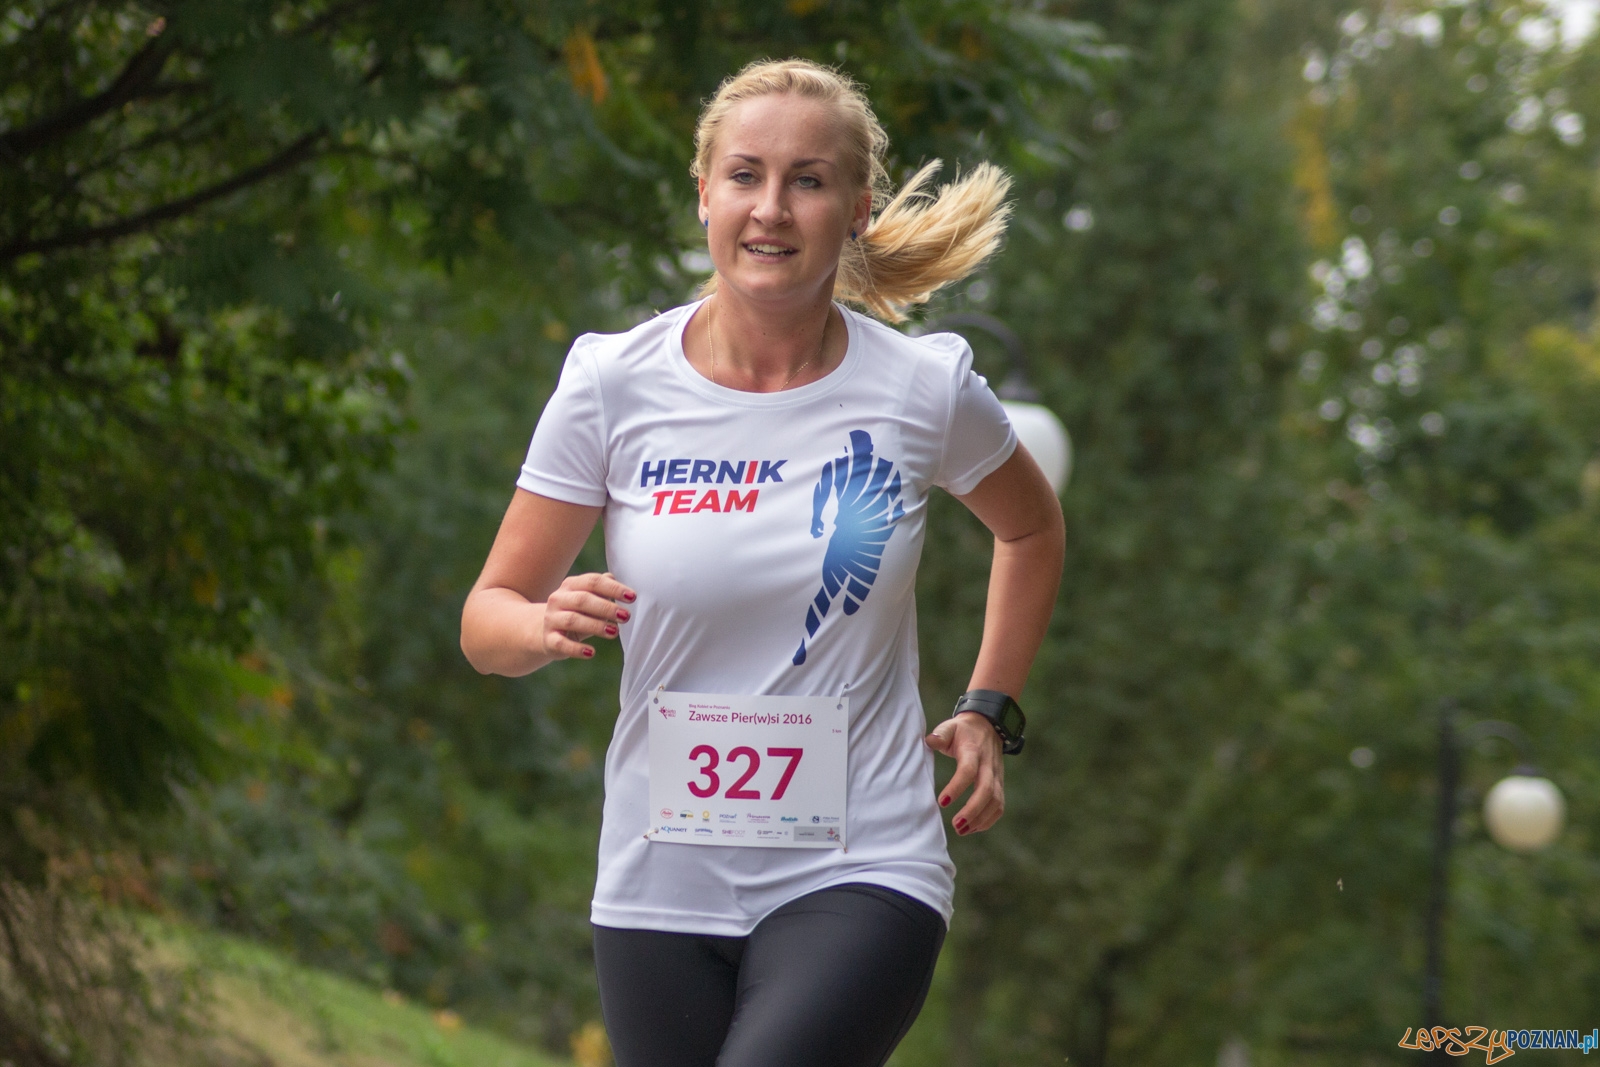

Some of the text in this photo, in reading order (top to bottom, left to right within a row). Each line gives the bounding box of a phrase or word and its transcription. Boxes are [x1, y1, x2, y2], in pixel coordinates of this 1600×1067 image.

[640, 459, 788, 487] HERNIK
[652, 489, 759, 516] TEAM
[689, 710, 728, 722] Zawsze
[731, 712, 780, 725] Pier(w)si
[783, 713, 812, 725] 2016
[687, 744, 803, 800] 327
